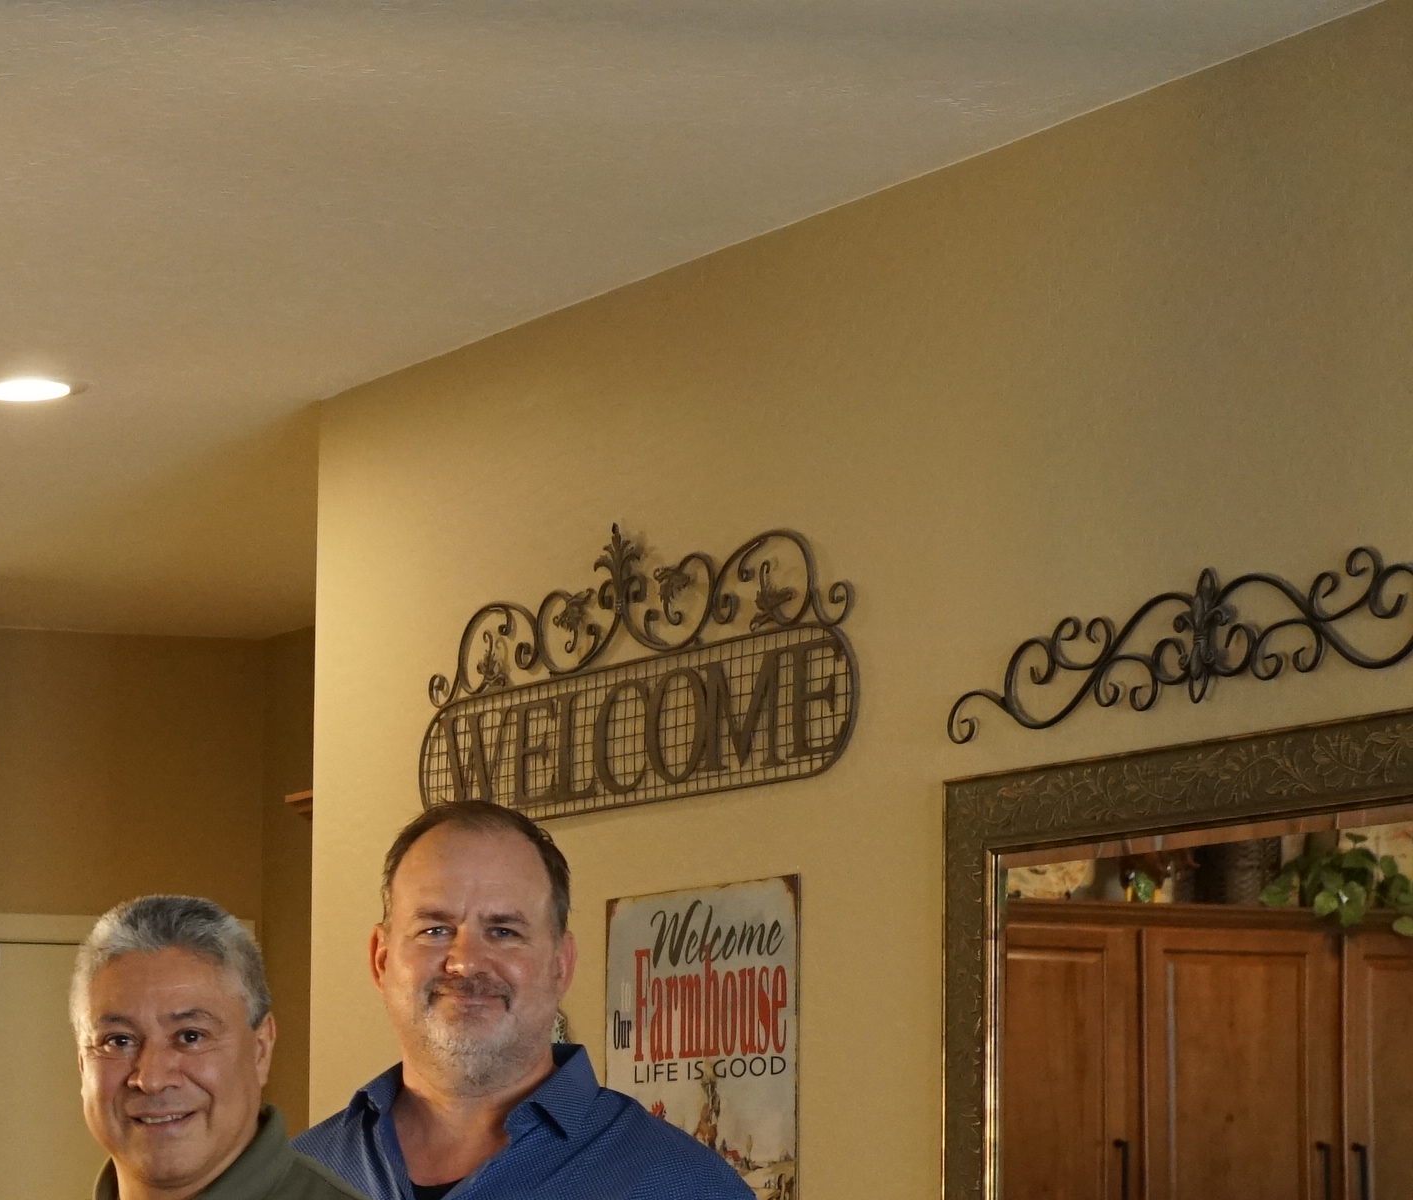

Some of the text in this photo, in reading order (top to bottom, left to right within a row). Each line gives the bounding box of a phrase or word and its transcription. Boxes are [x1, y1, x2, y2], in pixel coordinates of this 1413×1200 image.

[440, 639, 848, 804] WELCOME
[649, 898, 786, 969] Welcome
[613, 1009, 632, 1050] Our
[633, 944, 788, 1062] Farmhouse
[633, 1055, 787, 1084] LIFE IS GOOD
